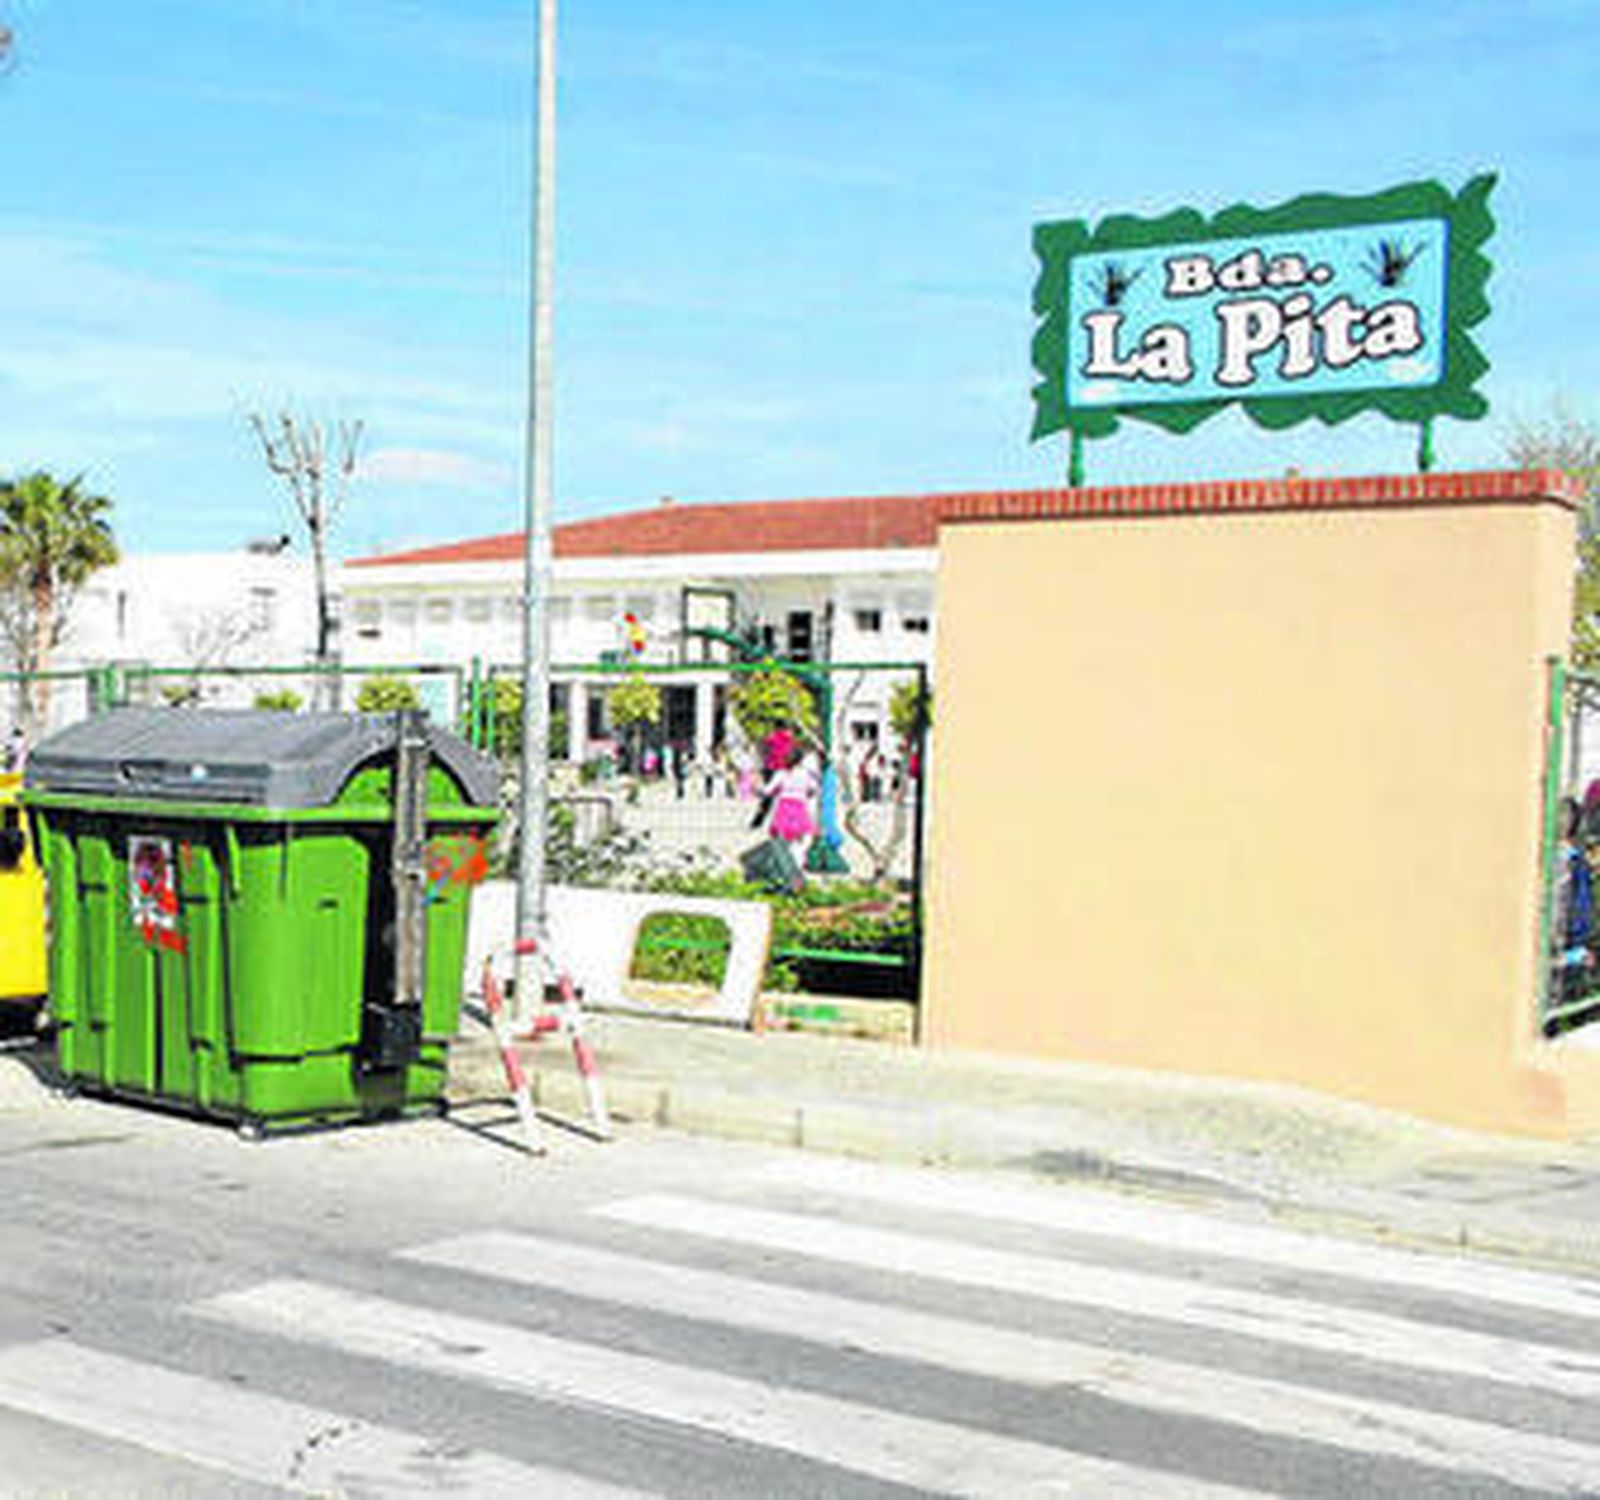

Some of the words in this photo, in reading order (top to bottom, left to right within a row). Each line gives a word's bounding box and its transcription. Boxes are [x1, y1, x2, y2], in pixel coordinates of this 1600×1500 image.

[1165, 250, 1332, 296] Bda.
[1083, 311, 1192, 382] La
[1215, 295, 1421, 385] Pita
